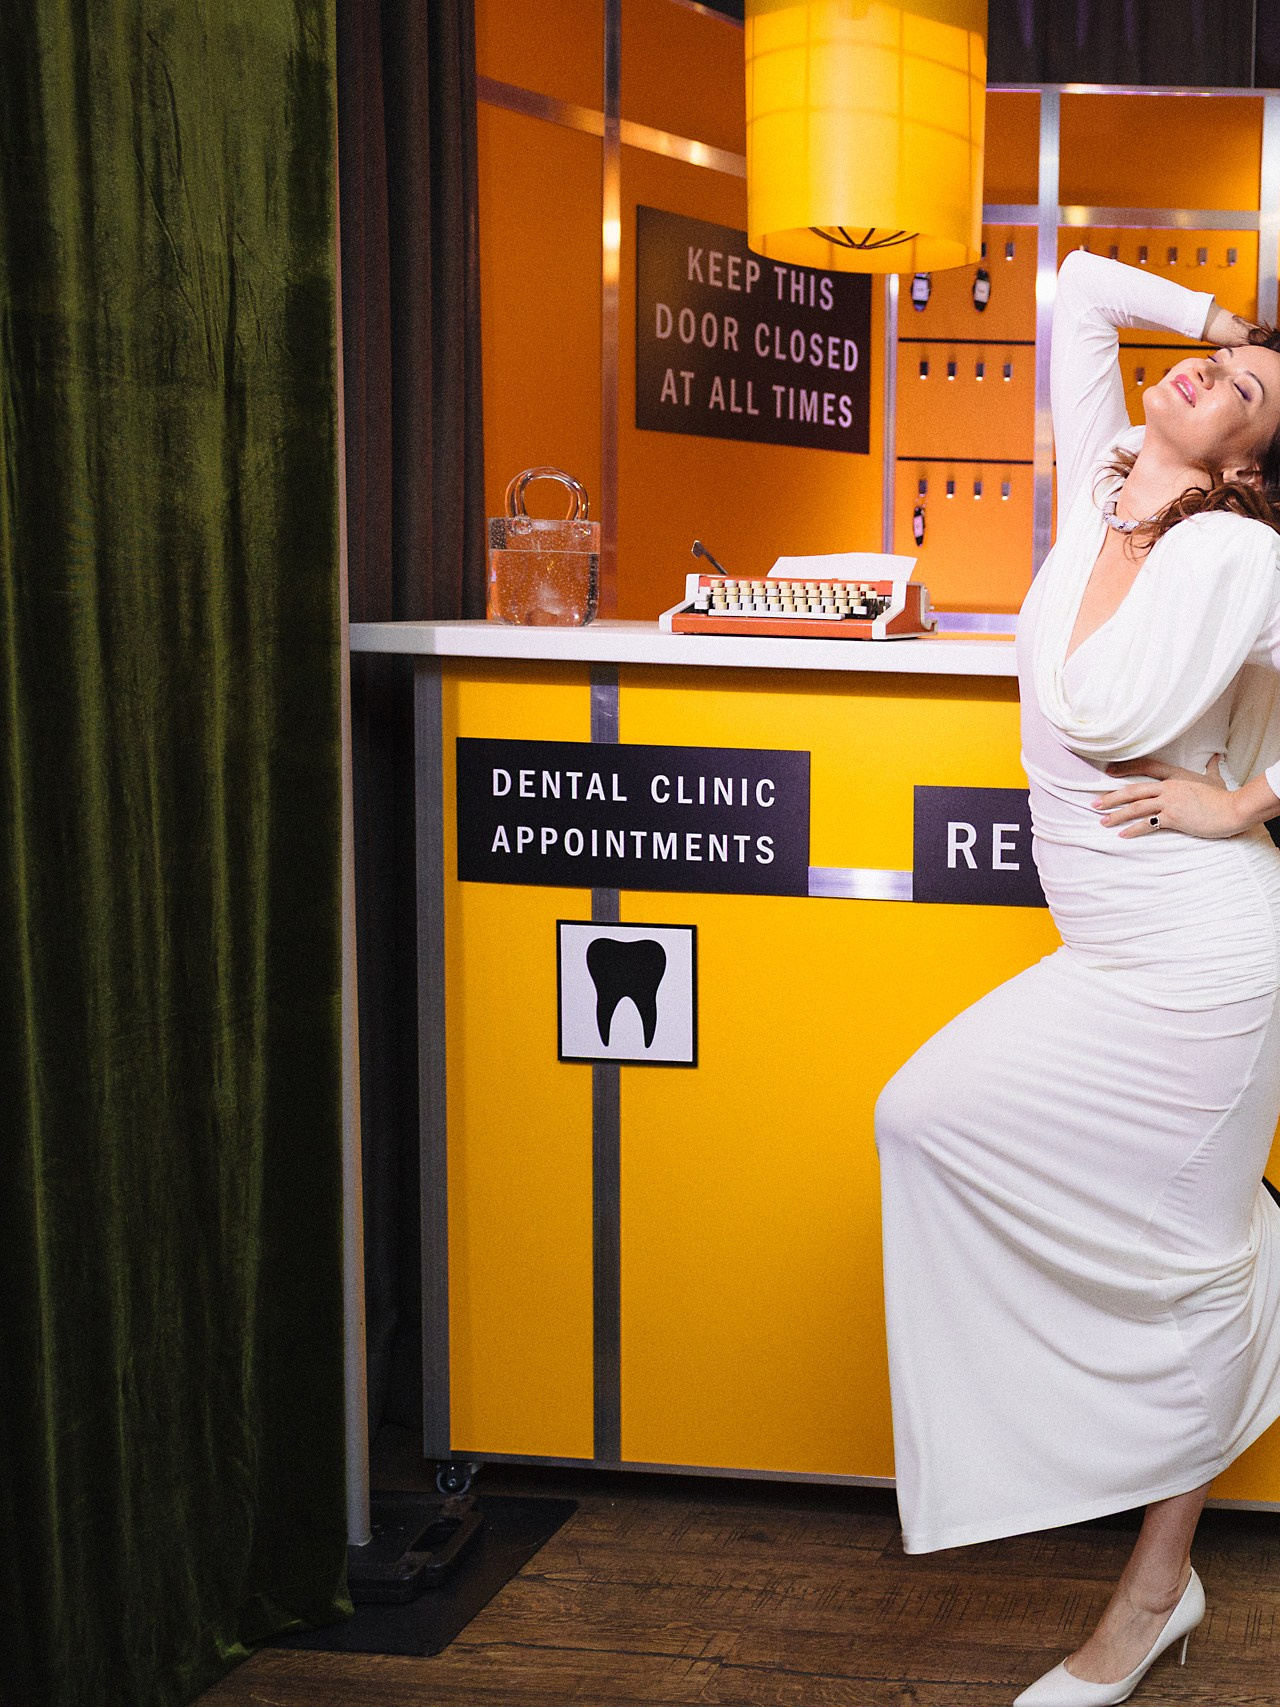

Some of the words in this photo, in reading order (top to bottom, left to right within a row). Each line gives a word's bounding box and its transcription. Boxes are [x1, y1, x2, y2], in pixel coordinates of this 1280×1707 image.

[687, 246, 760, 293] KEEP
[774, 266, 834, 311] THIS
[655, 303, 739, 352] DOOR
[755, 323, 858, 372] CLOSED
[661, 369, 694, 406] AT
[709, 376, 759, 415] ALL
[772, 385, 853, 428] TIMES
[492, 768, 628, 802] DENTAL
[651, 774, 776, 808] CLINIC
[491, 825, 775, 864] APPOINTMENTS
